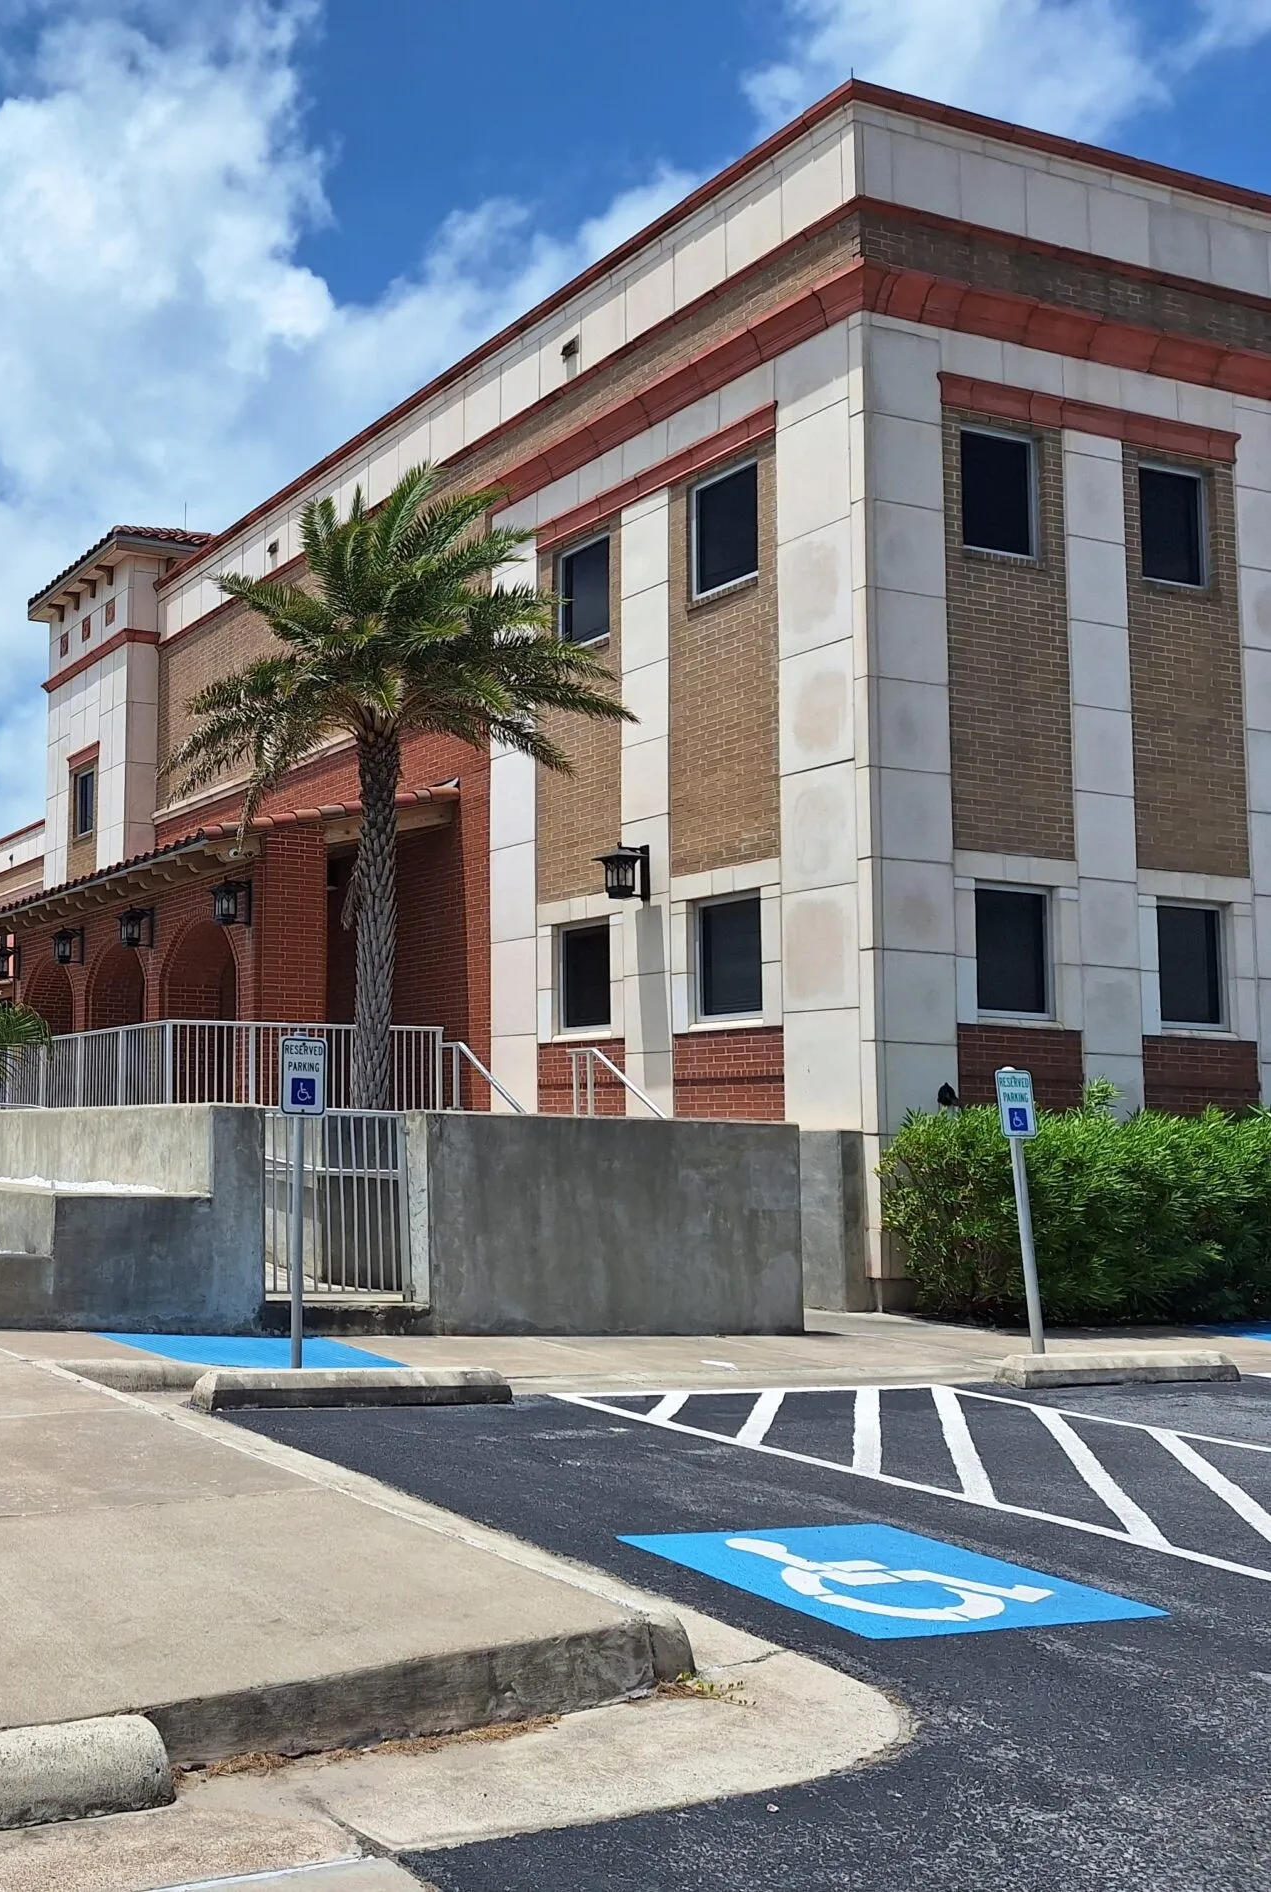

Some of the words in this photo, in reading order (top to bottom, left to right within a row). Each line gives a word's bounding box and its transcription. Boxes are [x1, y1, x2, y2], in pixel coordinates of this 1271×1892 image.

[285, 1045, 323, 1056] RESERVED
[288, 1061, 320, 1072] PARKING
[999, 1077, 1029, 1088] RESERVED
[1002, 1092, 1028, 1103] PARKING
